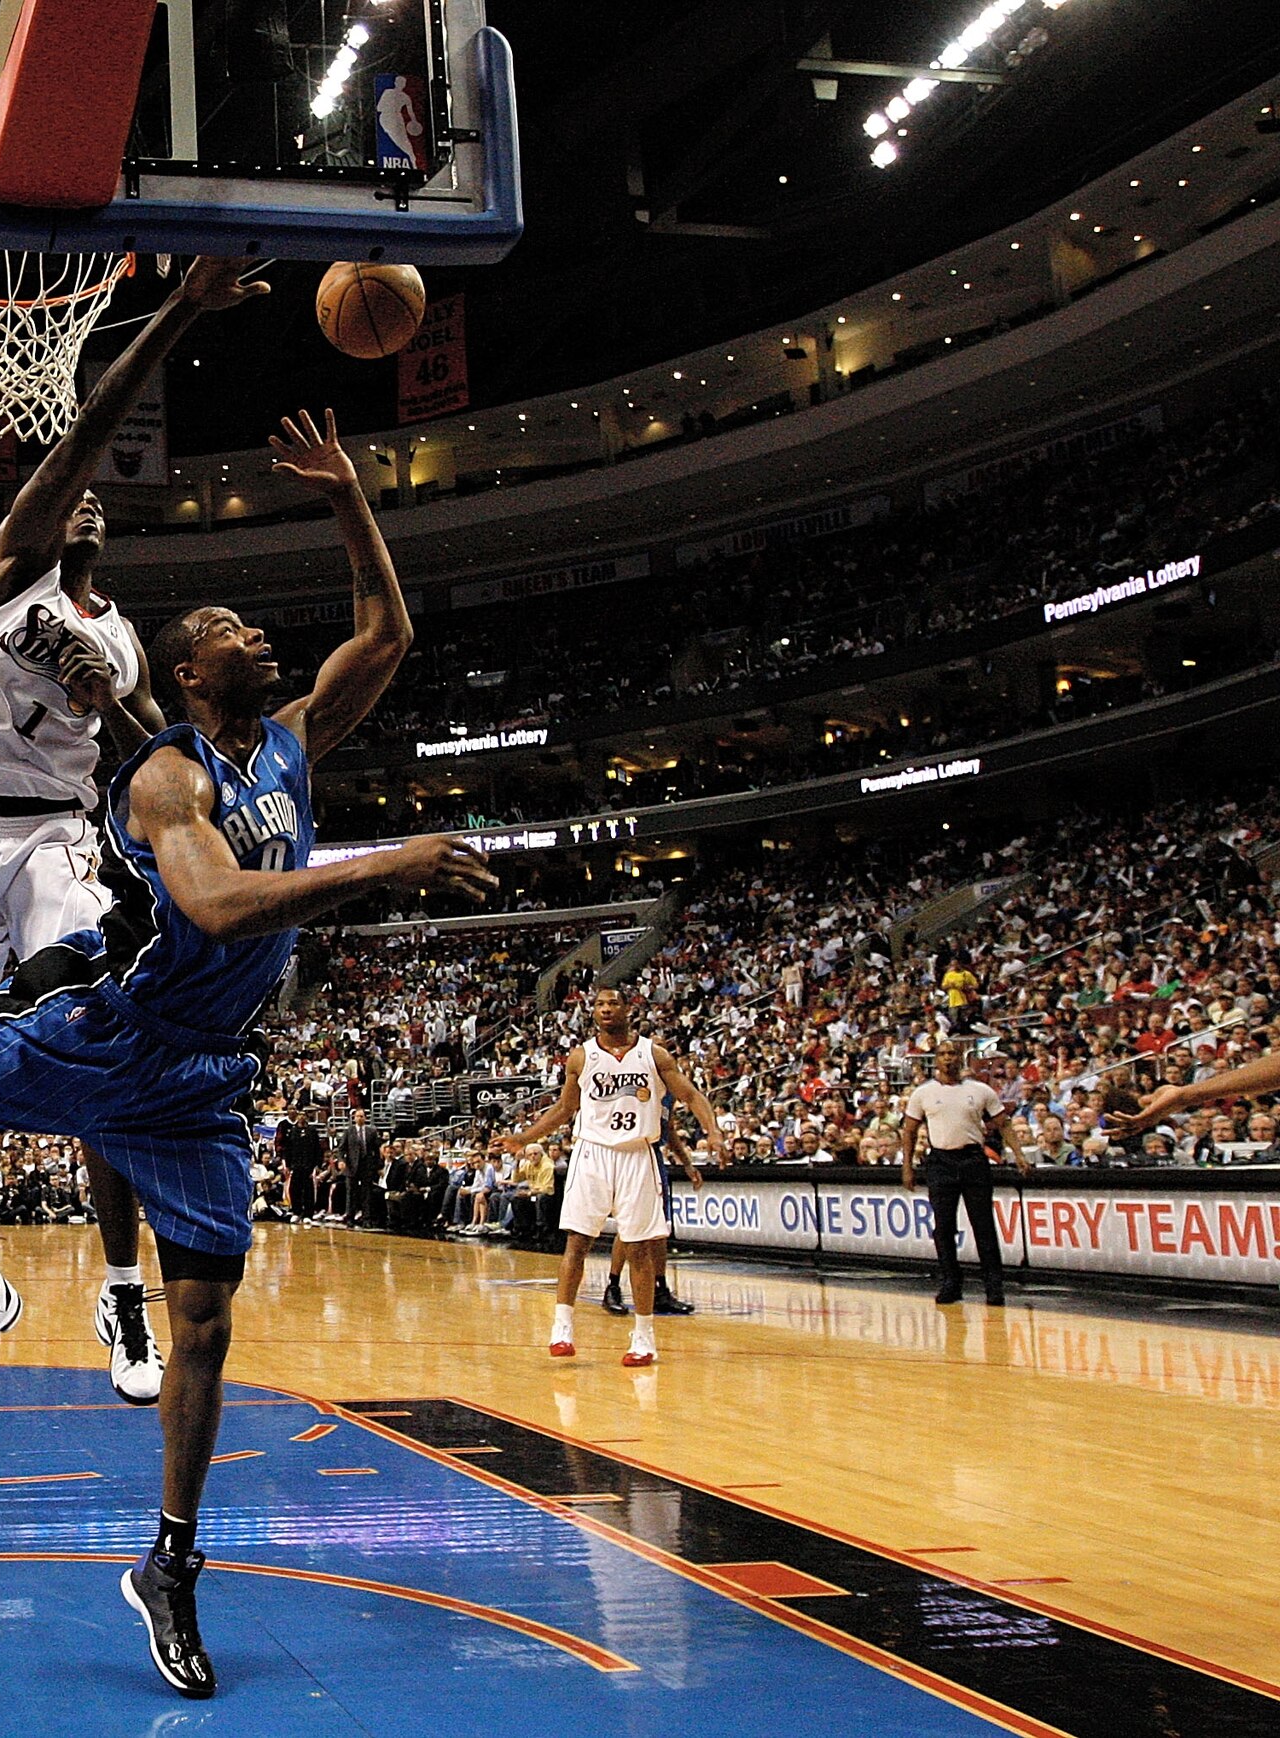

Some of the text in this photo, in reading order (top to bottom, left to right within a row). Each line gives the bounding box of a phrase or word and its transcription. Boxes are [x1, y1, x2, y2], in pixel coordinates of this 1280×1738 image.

[407, 326, 454, 353] JOEL
[416, 353, 448, 385] 46
[572, 561, 617, 586] TEAM
[1044, 555, 1200, 623] Pennsylvania Lottery
[13, 700, 48, 741] 1
[416, 729, 547, 757] Pennsylvania Lottery
[861, 759, 980, 793] Pennsylvania Lottery
[590, 1072, 649, 1098] SIXERS
[610, 1111, 637, 1131] 33
[780, 1195, 843, 1233] ONE
[993, 1199, 1108, 1249] VERY
